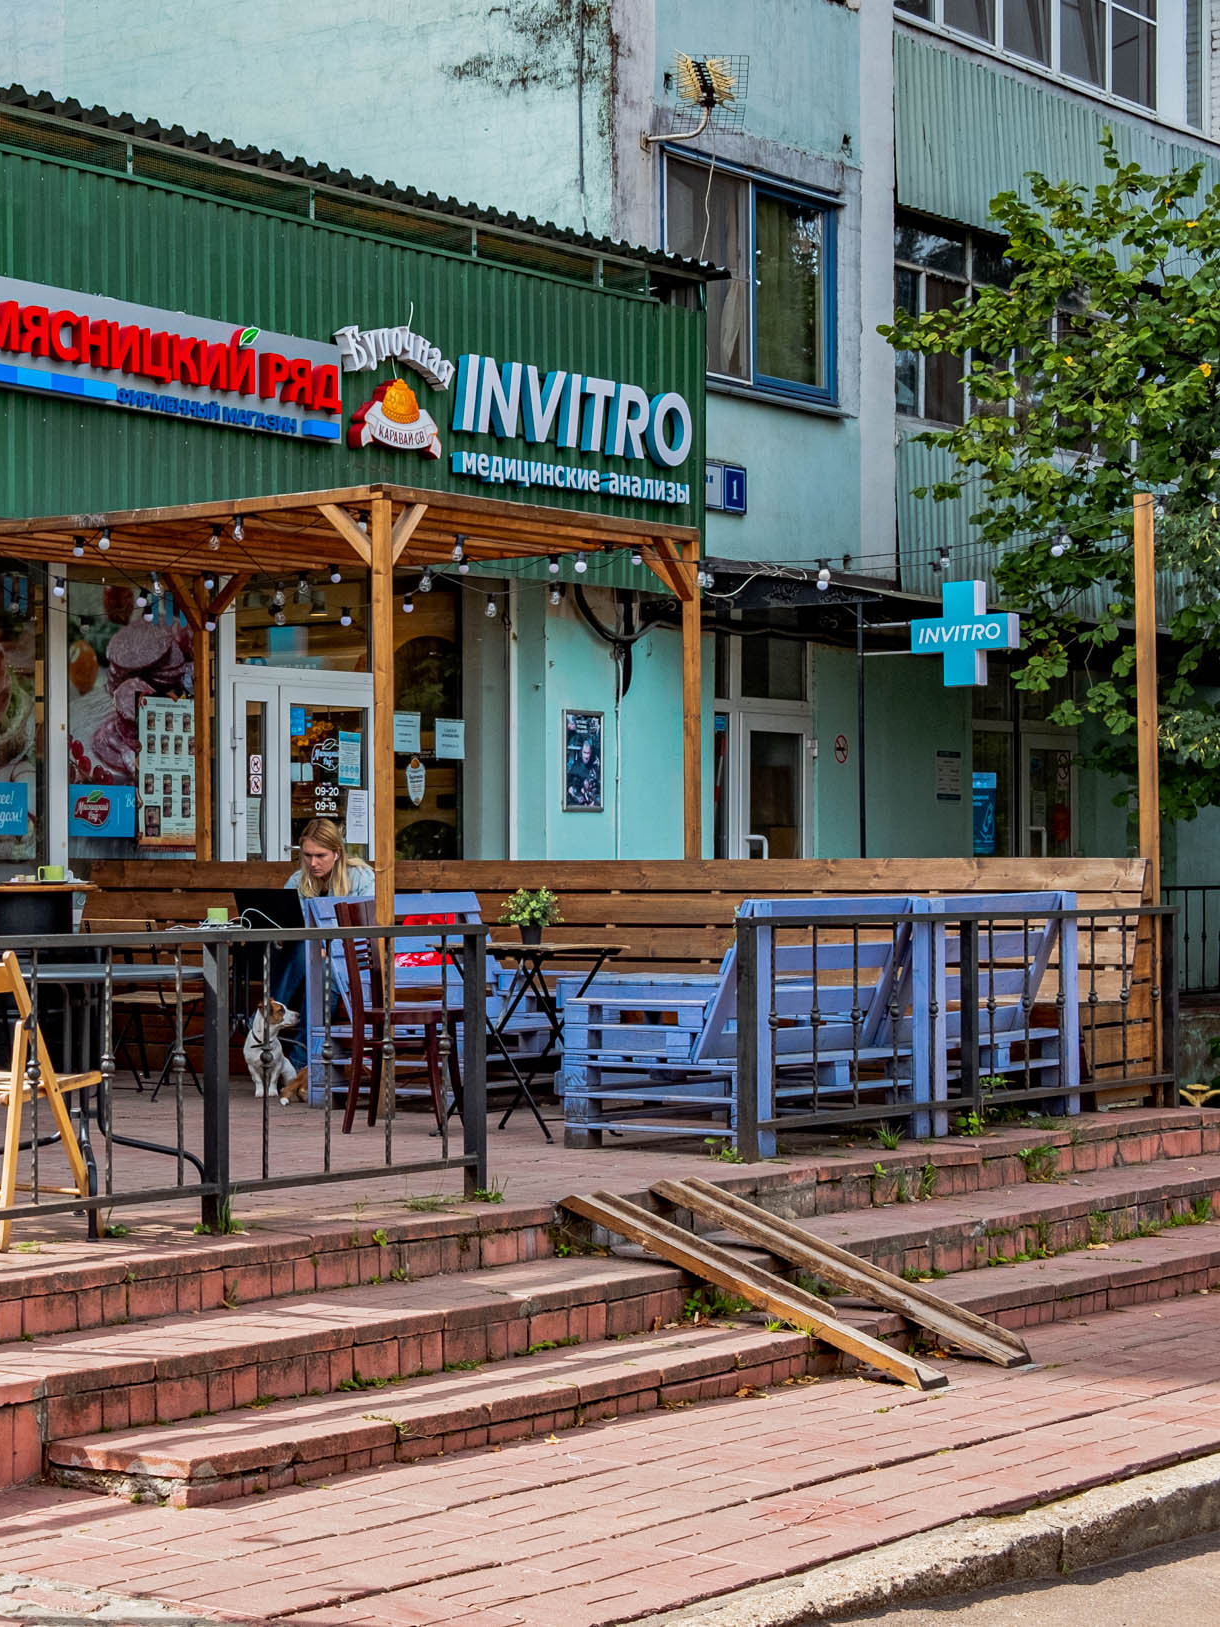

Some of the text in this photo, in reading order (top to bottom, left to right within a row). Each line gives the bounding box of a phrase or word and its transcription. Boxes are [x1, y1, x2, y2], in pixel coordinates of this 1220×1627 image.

[259, 353, 342, 414] РЯД
[117, 387, 297, 434] ФИРМЕННЫЙ МАГАЗИН
[453, 353, 692, 468] INVITRO
[453, 451, 690, 505] медицинские анализы
[731, 479, 739, 500] 1
[918, 622, 1001, 645] INVITRO
[314, 786, 340, 797] 09-20
[314, 801, 337, 811] 09-19
